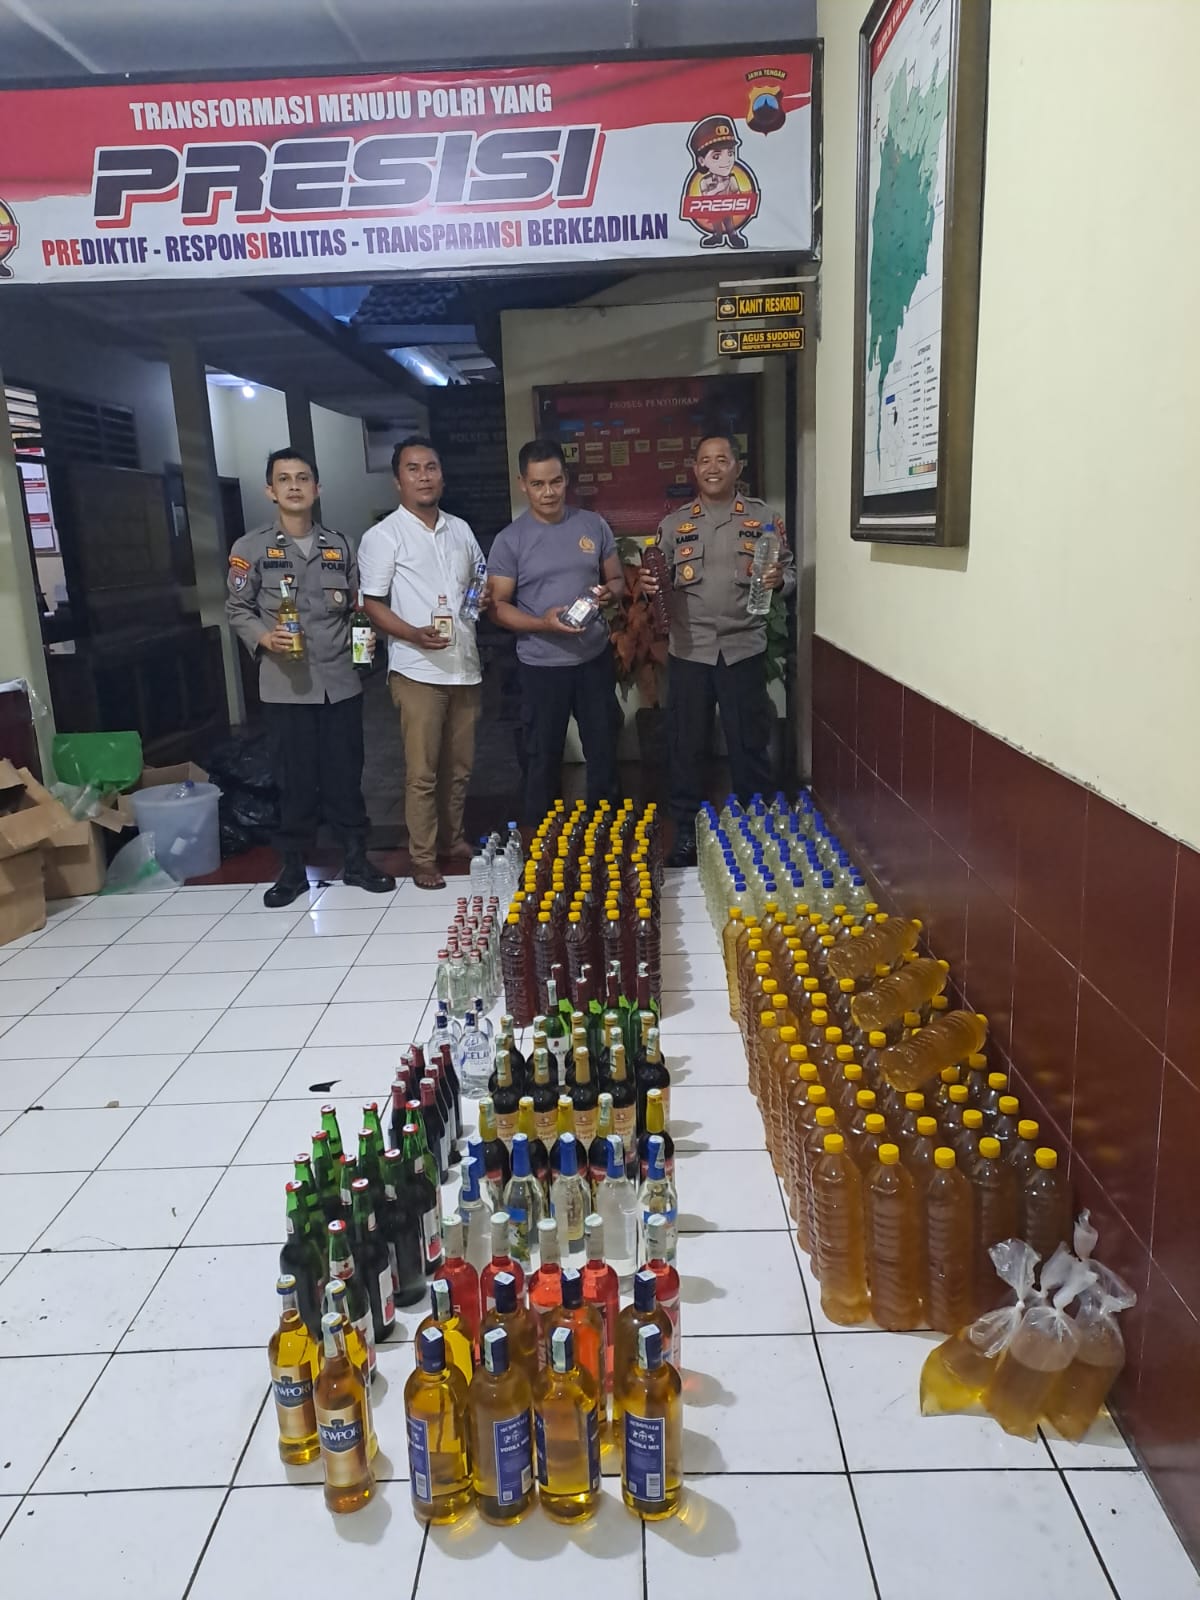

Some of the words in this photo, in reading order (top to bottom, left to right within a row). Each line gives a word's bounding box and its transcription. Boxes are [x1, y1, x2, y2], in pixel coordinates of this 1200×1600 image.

[747, 70, 763, 80] JAWA
[764, 69, 786, 79] TENGAH
[129, 95, 313, 131] TRANSFORMASI
[318, 90, 411, 124] MENUJU
[417, 86, 484, 118] POLRI
[490, 83, 552, 116] YANG
[94, 124, 605, 228] PRESISI
[689, 198, 751, 213] PRESISI
[42, 237, 148, 266] PREDIKTIF
[165, 229, 347, 263] RESPONSIBILITAS
[364, 220, 522, 254] TRANSPARANSI
[528, 213, 668, 246] BERKEADILAN
[740, 299, 763, 314] KANIT
[765, 296, 800, 313] RESKRIM
[742, 332, 765, 343] AGUS
[766, 330, 800, 341] SUDONO
